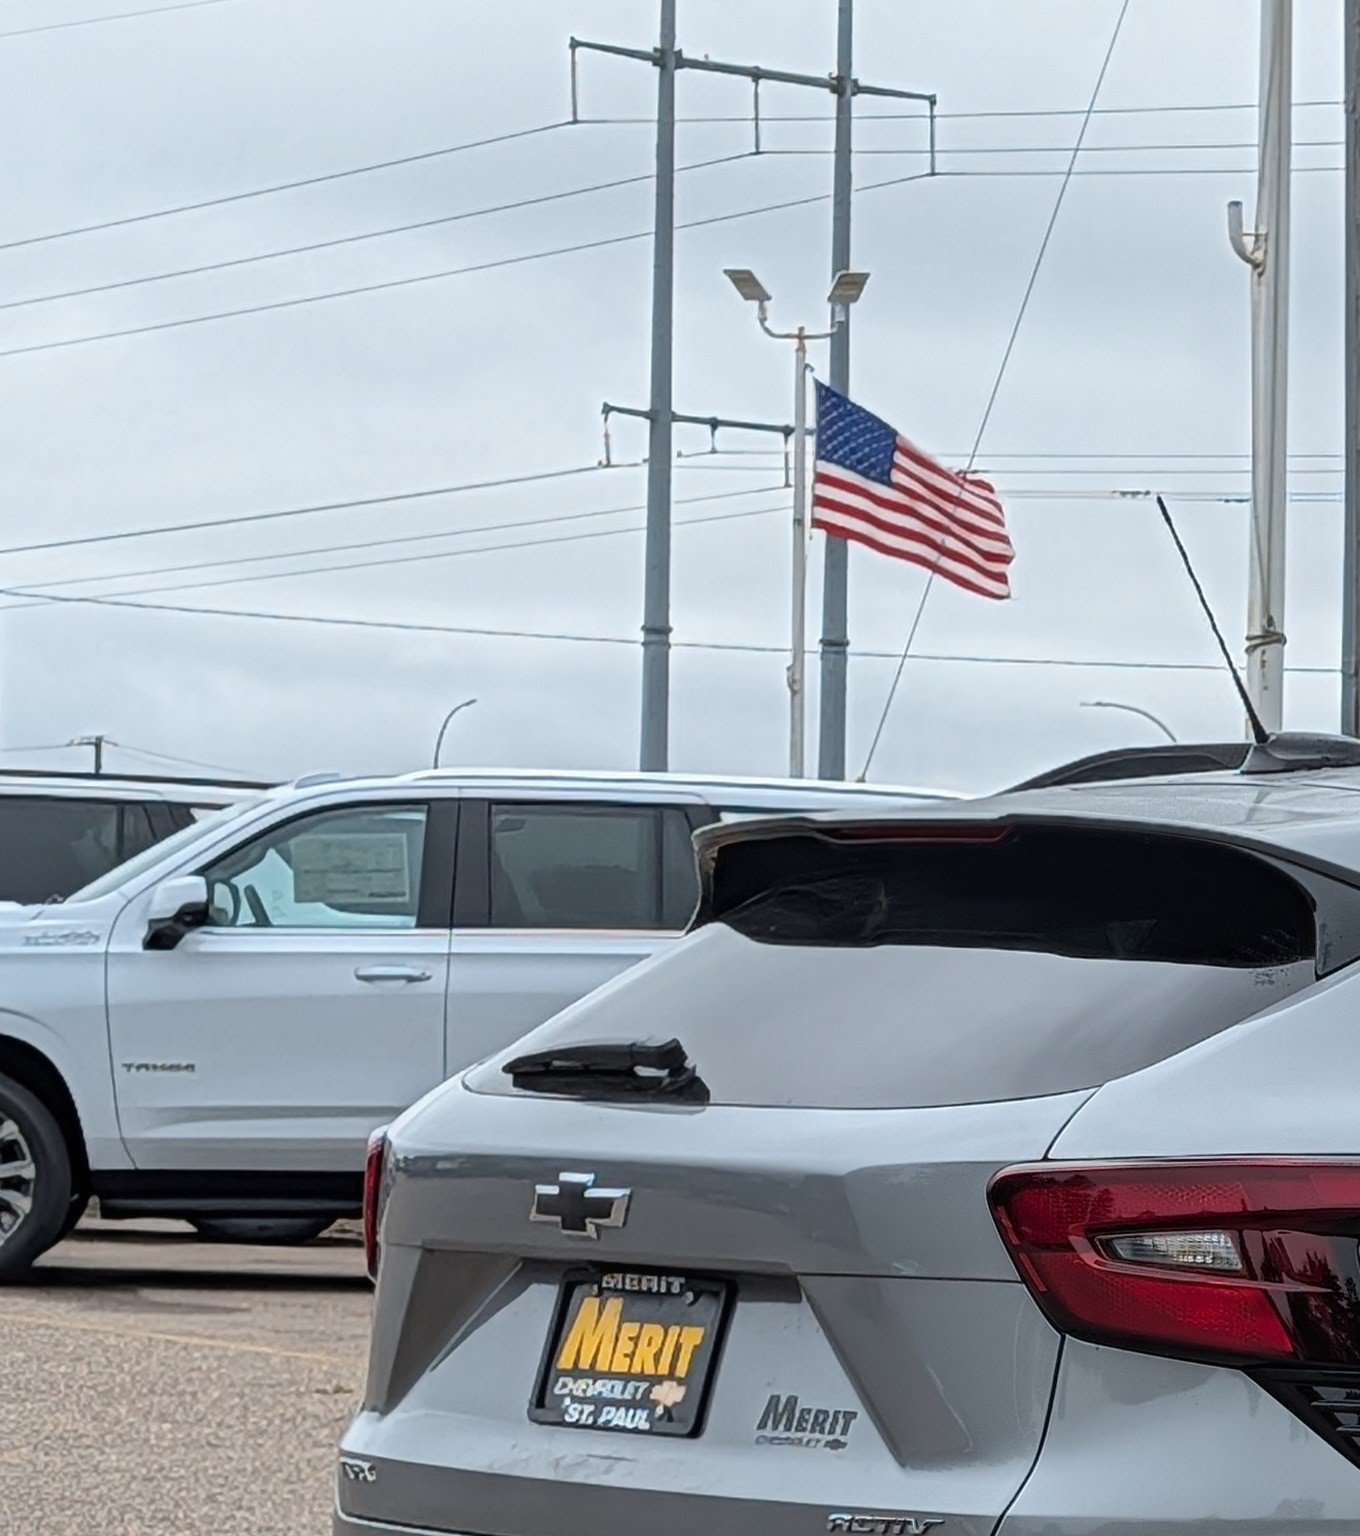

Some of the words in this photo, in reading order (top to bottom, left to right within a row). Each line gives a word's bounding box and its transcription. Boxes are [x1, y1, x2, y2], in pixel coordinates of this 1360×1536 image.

[602, 1273, 686, 1293] MERIT
[556, 1296, 705, 1378] MERIT
[597, 1406, 650, 1430] PAUL
[756, 1394, 859, 1436] MERIT
[827, 1512, 945, 1536] ACTIV
